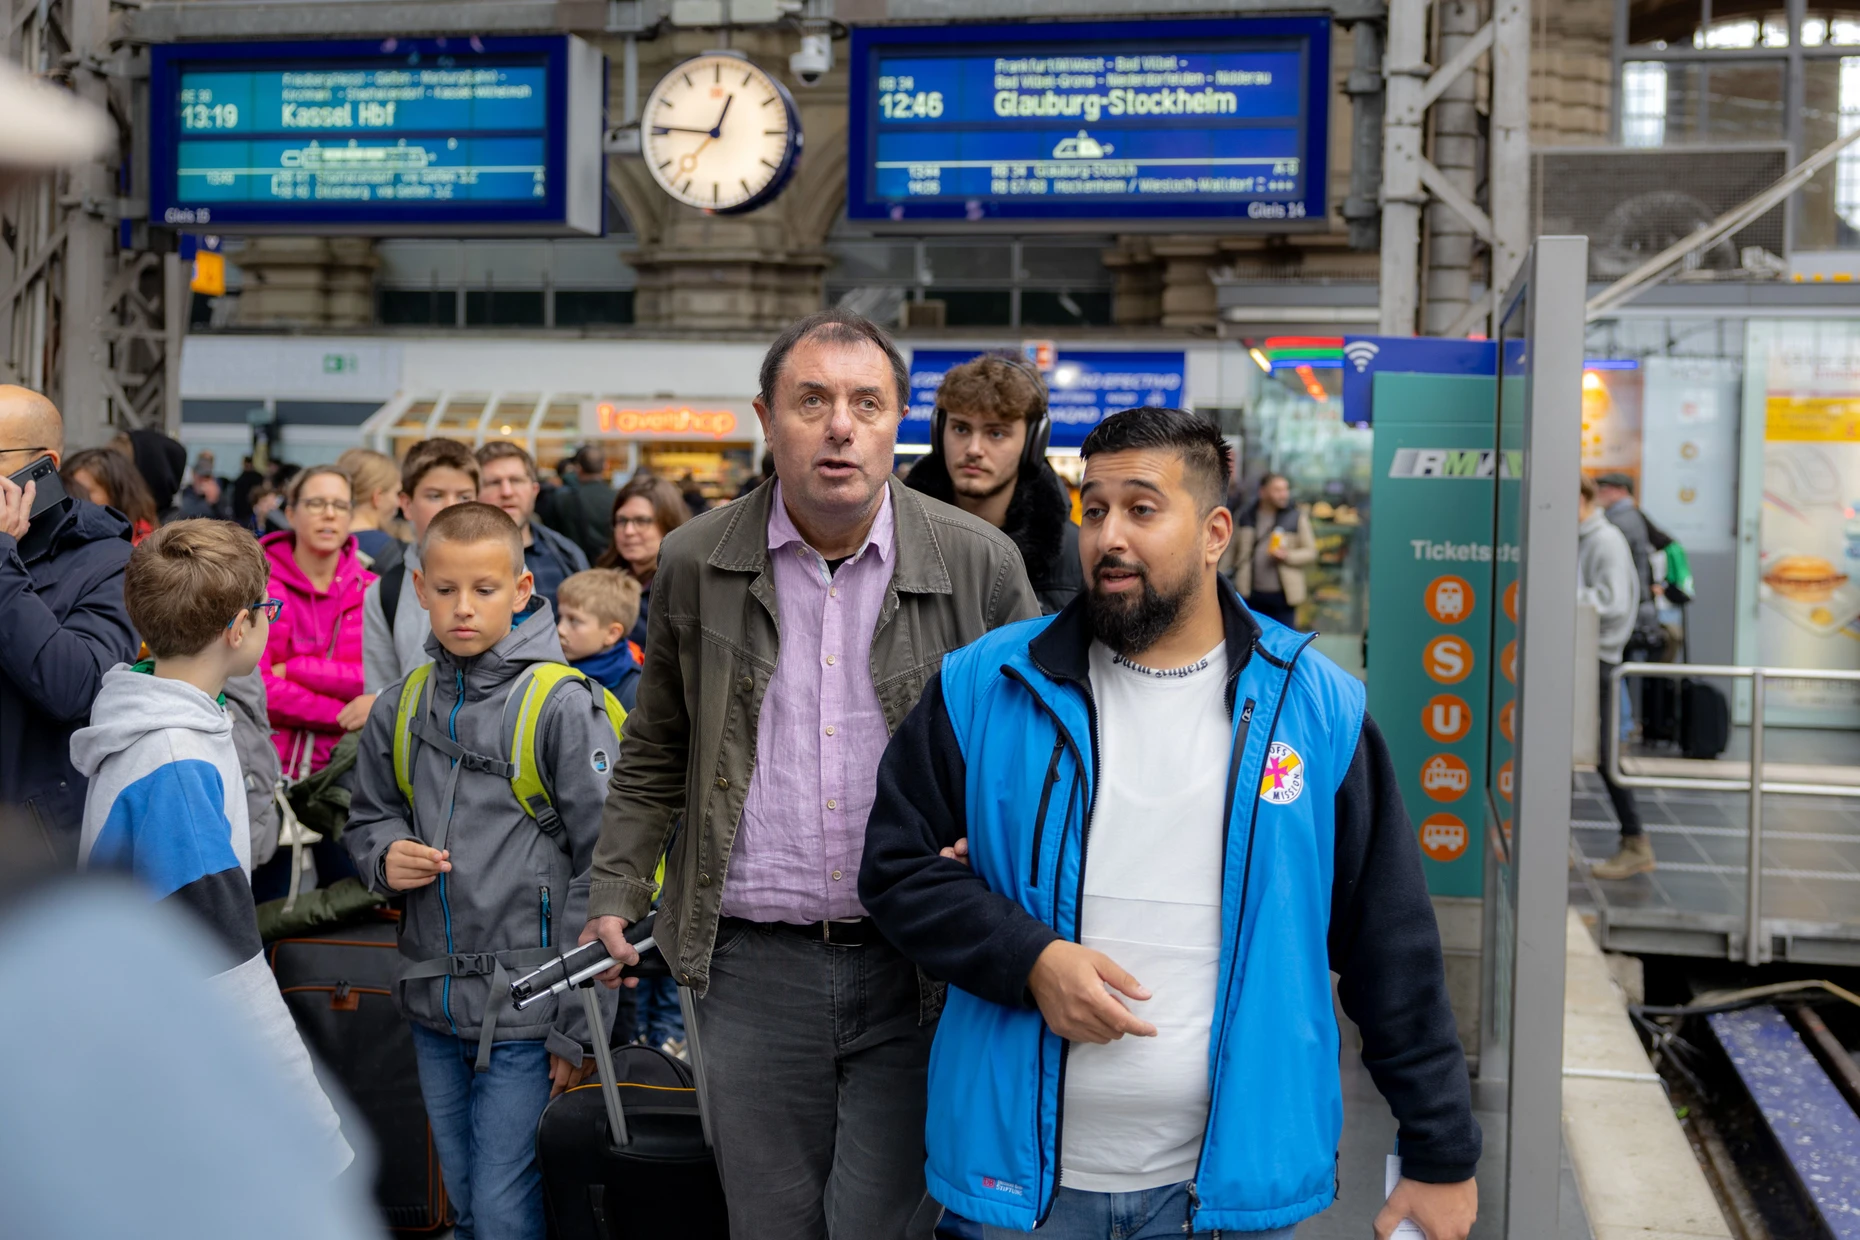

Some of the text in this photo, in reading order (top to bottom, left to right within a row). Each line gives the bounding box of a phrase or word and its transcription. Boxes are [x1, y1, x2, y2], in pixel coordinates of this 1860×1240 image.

[181, 103, 239, 129] 13:19
[281, 101, 396, 128] Kassel Hbf
[878, 91, 944, 118] 12:46
[993, 88, 1237, 122] Glauburg-Stockheim
[1247, 201, 1286, 219] Gleis
[1410, 540, 1492, 562] Tickets
[1273, 773, 1300, 800] MISSION
